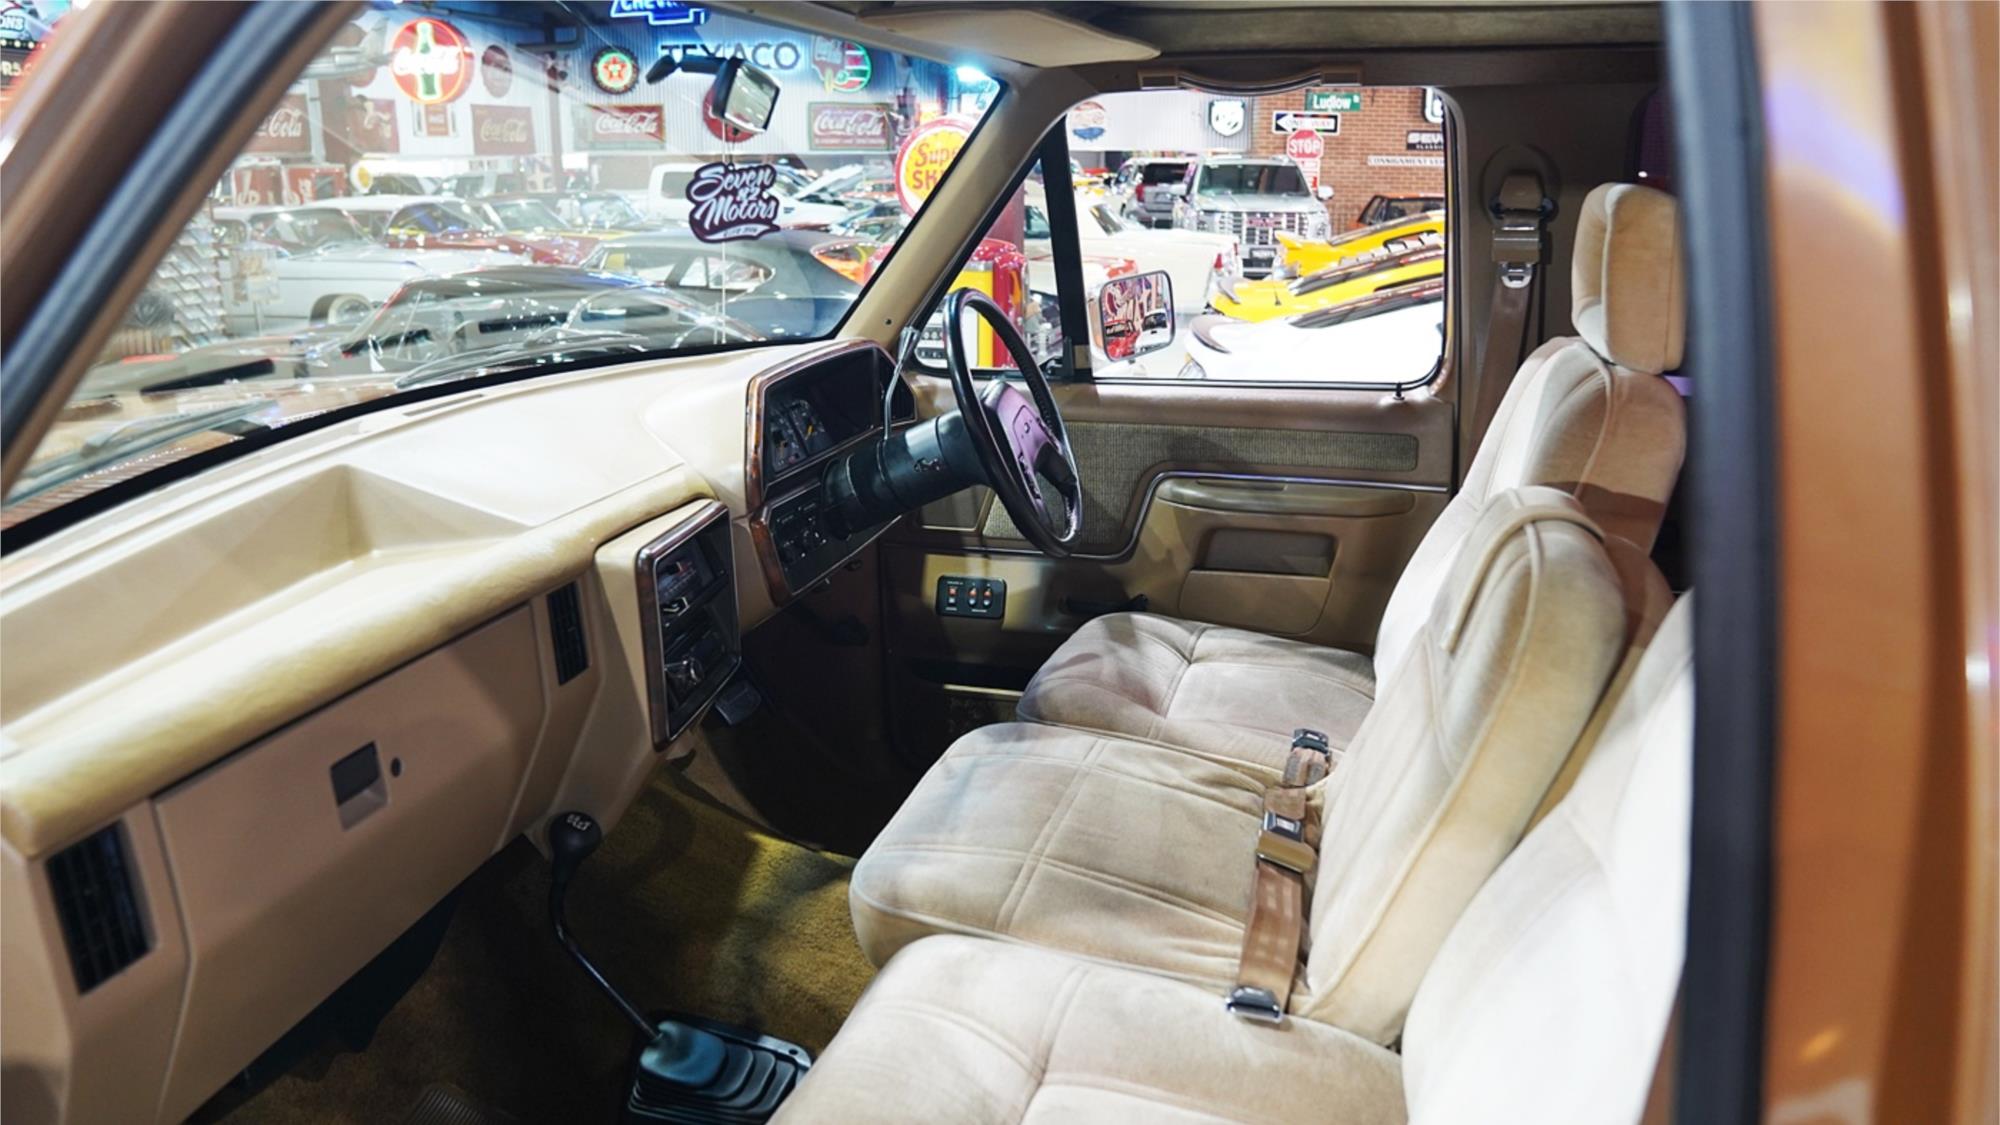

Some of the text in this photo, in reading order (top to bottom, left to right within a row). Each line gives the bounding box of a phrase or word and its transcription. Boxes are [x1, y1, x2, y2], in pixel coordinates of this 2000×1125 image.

[1313, 94, 1351, 110] Ludlow
[1289, 139, 1322, 153] STOP
[690, 165, 774, 201] Seven
[694, 195, 778, 230] Motors
